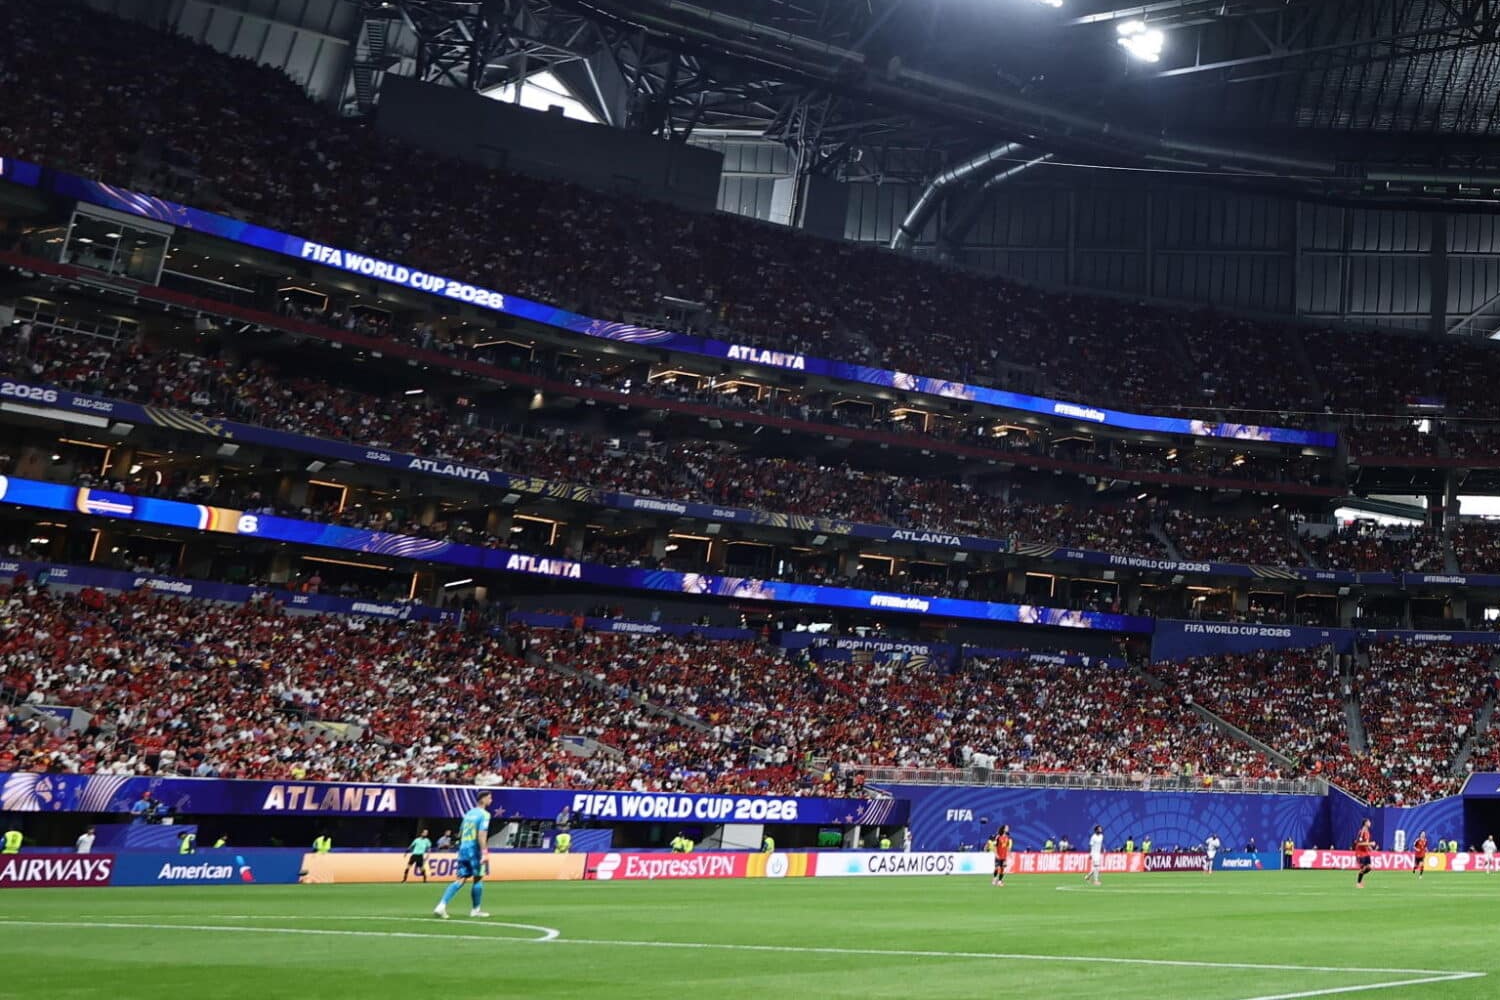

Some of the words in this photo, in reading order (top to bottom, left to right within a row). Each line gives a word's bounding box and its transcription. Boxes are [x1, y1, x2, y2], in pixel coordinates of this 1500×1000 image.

[301, 241, 342, 267] FIFA
[343, 252, 410, 283] WORLD
[410, 272, 446, 293] CUP
[445, 281, 504, 309] 2026
[727, 344, 805, 370] ATLANTA
[0, 382, 58, 403] 2026
[408, 458, 489, 482] ATLANTA
[892, 530, 961, 545] ATLANTA
[507, 554, 581, 579] ATLANTA
[1110, 555, 1128, 565] FIFA
[1128, 557, 1157, 568] WORLD
[1158, 560, 1177, 571] CUP
[1177, 562, 1210, 572] 2026
[1184, 624, 1205, 634] FIFA
[1205, 625, 1239, 634] WORLD
[1240, 627, 1258, 636] CUP
[1259, 628, 1291, 637] 2026
[263, 784, 398, 812] ATLANTA
[572, 794, 617, 817] FIFA
[621, 795, 693, 819] WORLD
[694, 797, 734, 819] CUP
[734, 798, 799, 820] 2026
[946, 809, 973, 821] FIFA
[0, 859, 111, 881] AIRWAYS
[159, 863, 233, 880] American
[625, 856, 735, 879] ExpressVPN
[868, 855, 954, 873] CASAMIGOS
[1020, 853, 1037, 872] THE
[1039, 853, 1062, 872] HOME
[1064, 853, 1089, 872] DEPOT
[1100, 853, 1128, 872] LIVERS
[1145, 855, 1171, 870] QATAR
[1173, 854, 1208, 870] AIRWAYS
[1222, 858, 1252, 867] American
